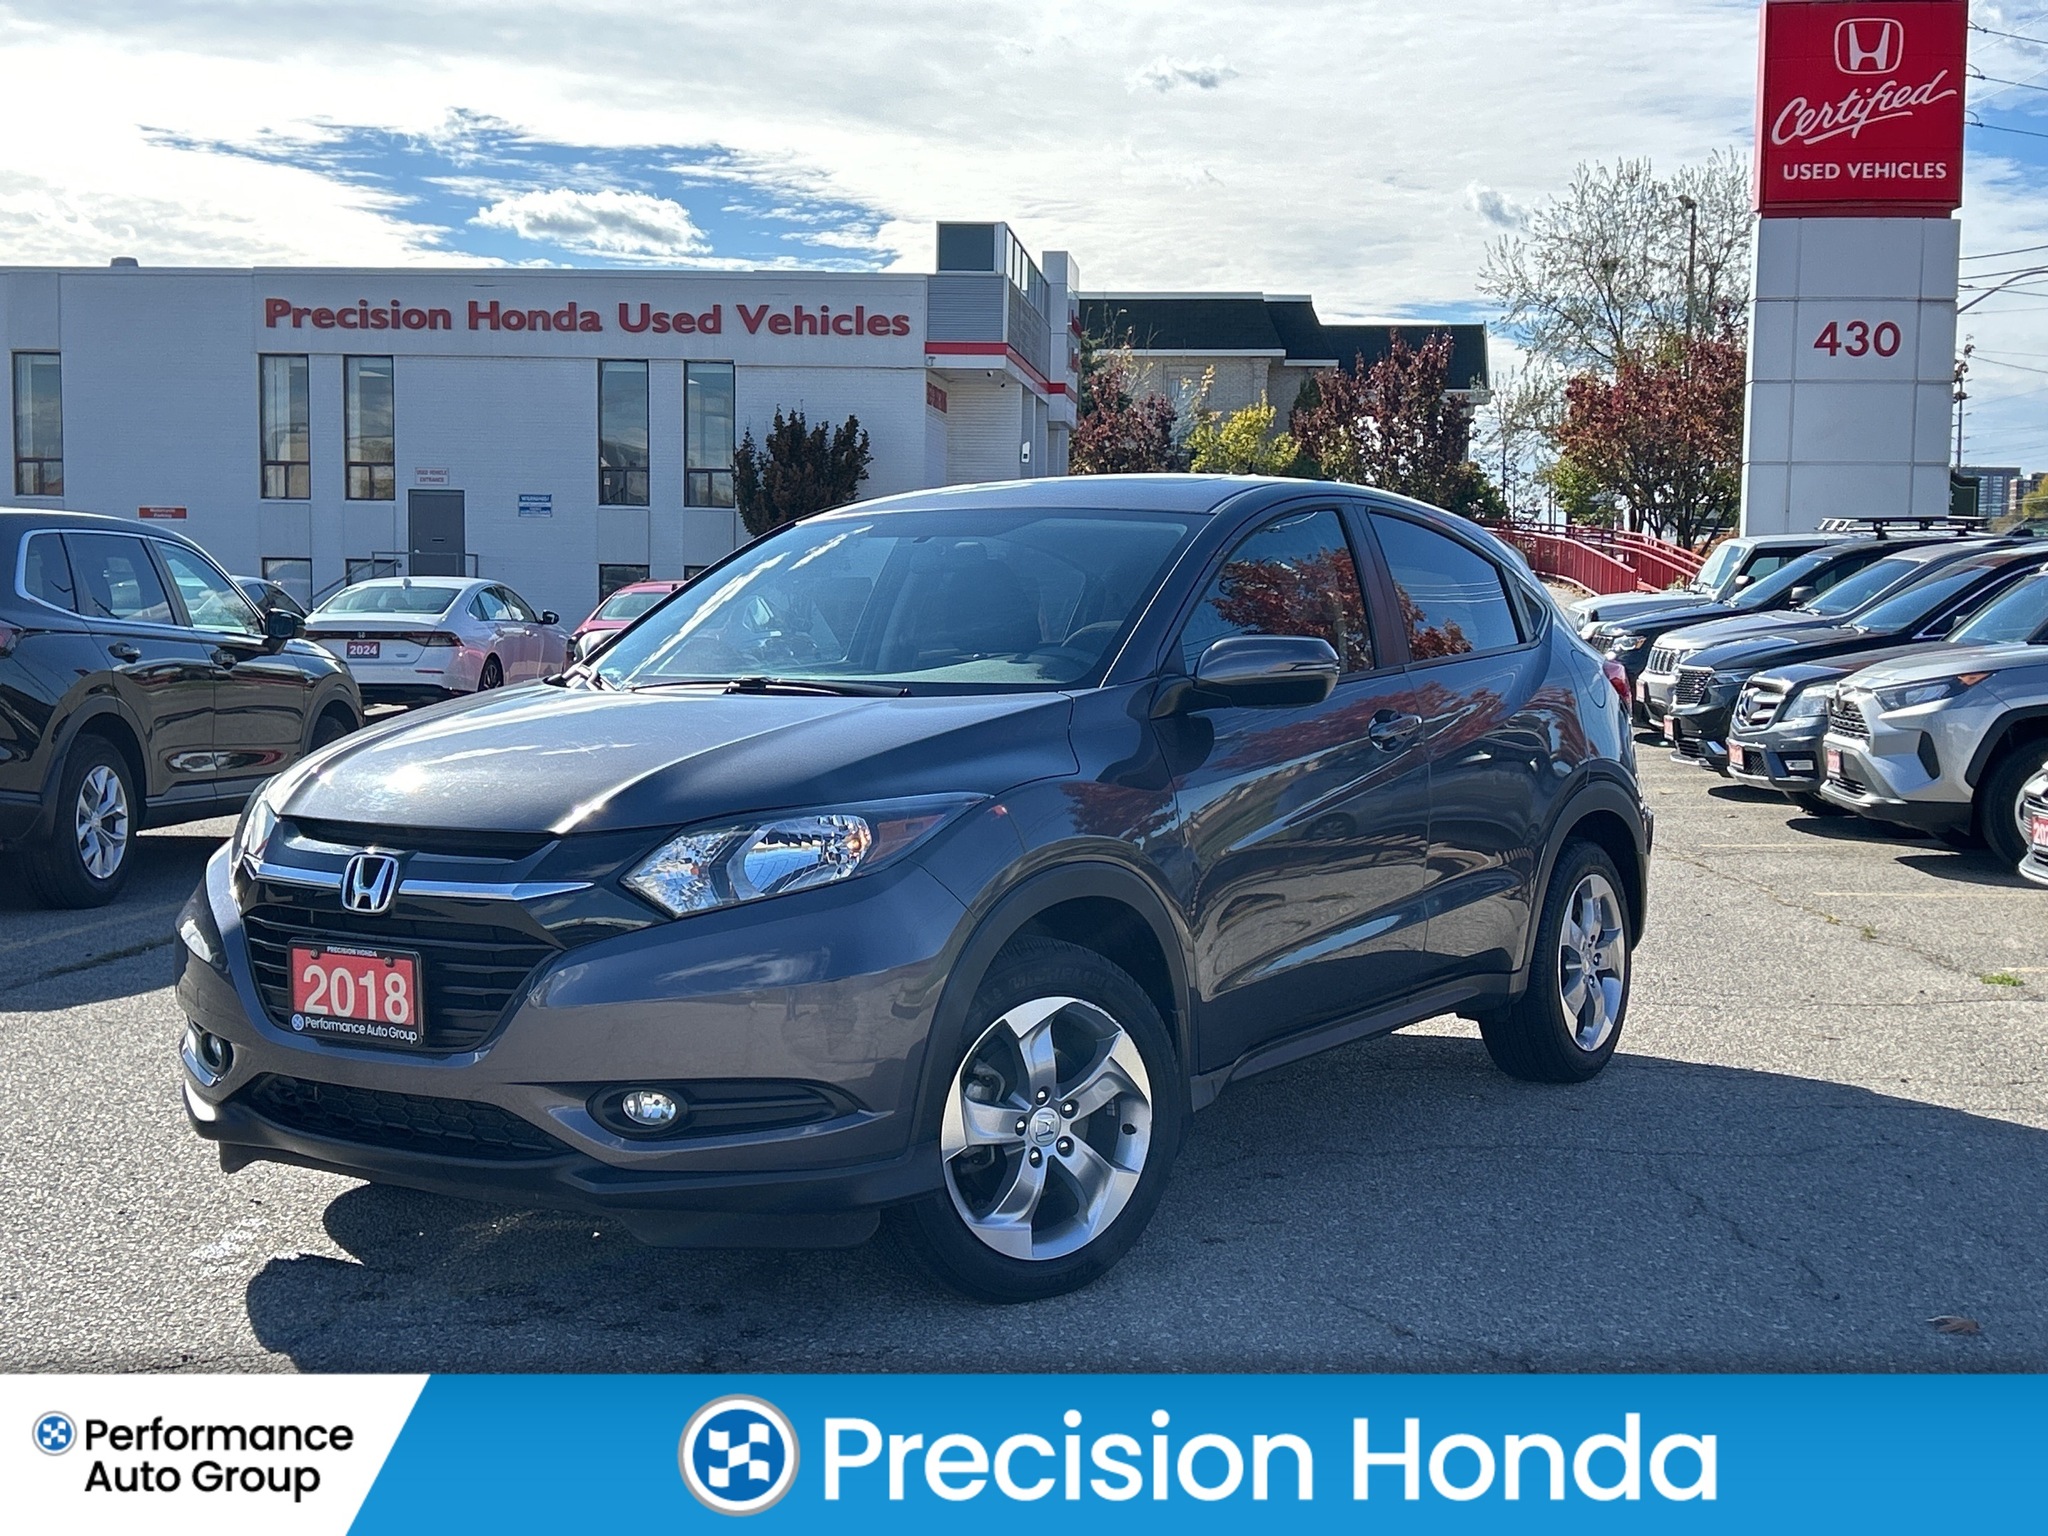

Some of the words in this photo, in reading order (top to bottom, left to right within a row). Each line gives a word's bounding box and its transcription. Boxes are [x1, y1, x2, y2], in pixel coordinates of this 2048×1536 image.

[1771, 69, 1957, 146] Certified
[1783, 163, 1841, 181] USED
[1847, 162, 1947, 180] VEHICLES
[265, 298, 452, 330] Precision
[467, 300, 603, 333] Honda
[618, 302, 722, 335] Used
[735, 304, 911, 337] Vehicles
[1813, 320, 1902, 358] 430
[349, 645, 378, 655] 2024
[326, 945, 357, 955] PRECISION
[357, 949, 378, 958] HONDA
[303, 964, 410, 1025] 2018
[305, 1016, 366, 1035] Performance
[366, 1024, 388, 1038] Auto
[388, 1027, 418, 1045] Group
